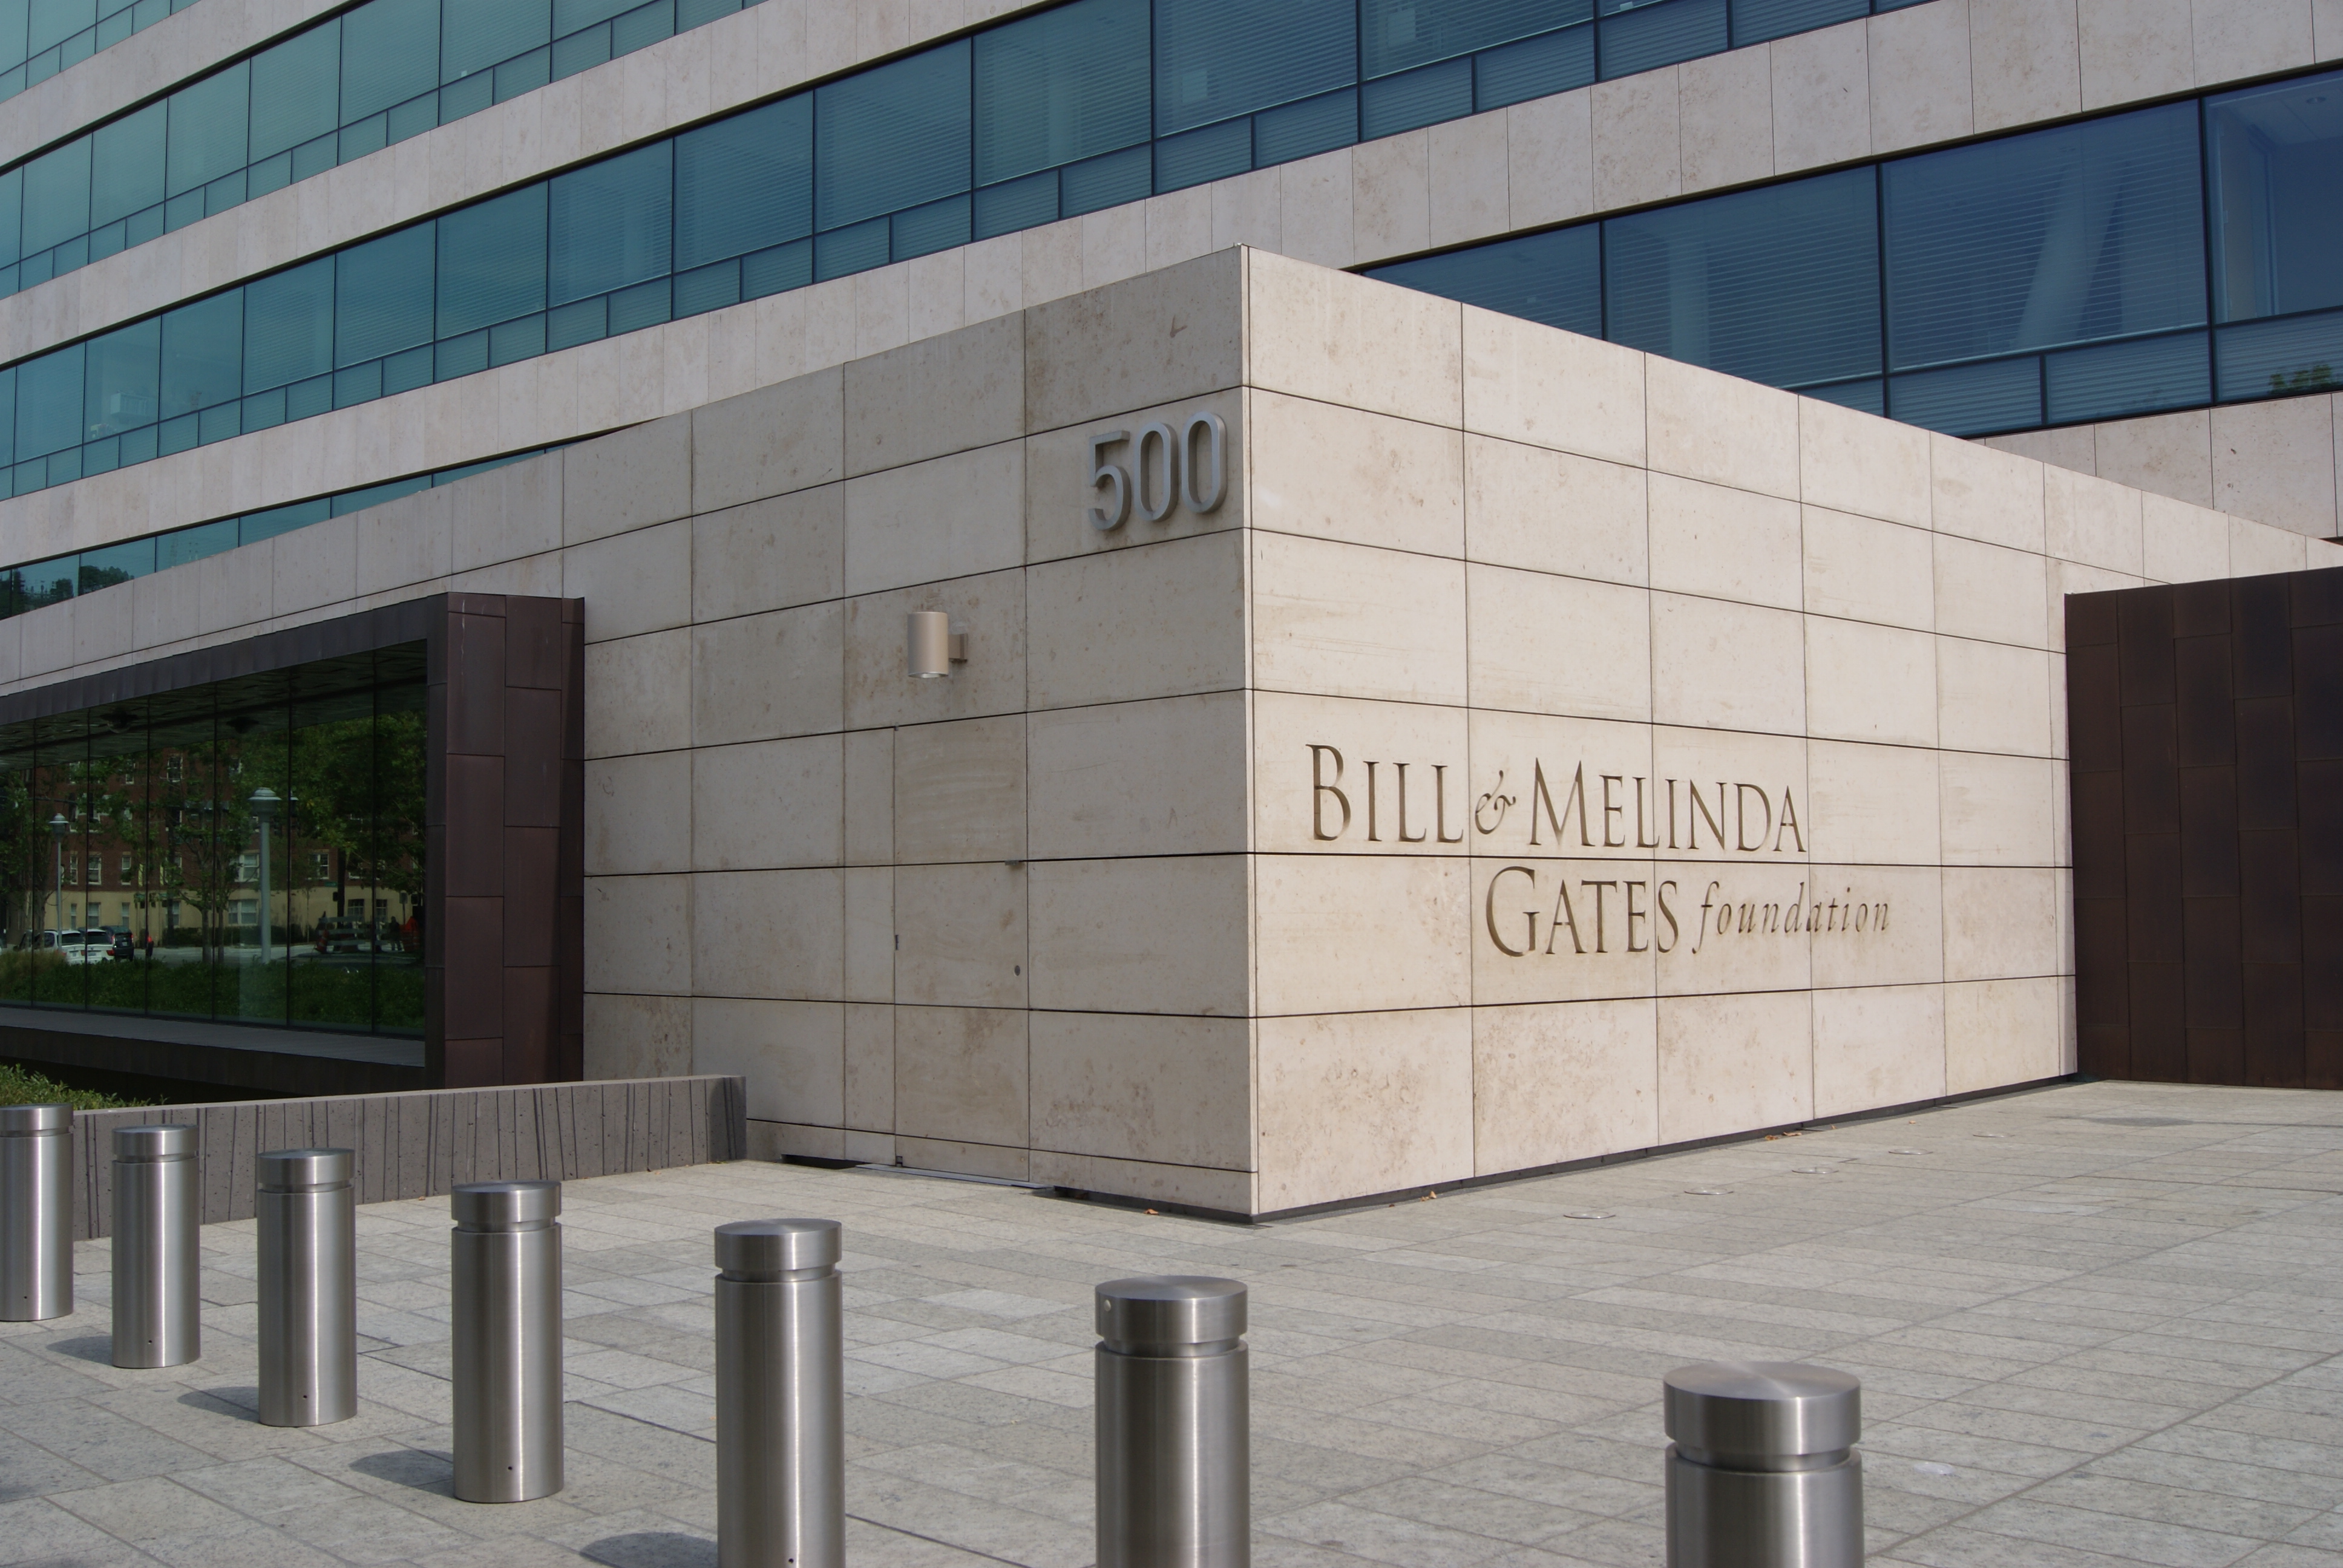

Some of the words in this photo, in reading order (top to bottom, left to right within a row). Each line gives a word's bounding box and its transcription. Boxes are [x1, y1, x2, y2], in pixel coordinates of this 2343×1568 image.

[1088, 411, 1227, 531] 500
[1305, 743, 1464, 843] BILL
[1475, 769, 1516, 834] &
[1529, 757, 1806, 852] MELINDA
[1486, 866, 1679, 957] GATES
[1693, 881, 1890, 954] foundation
